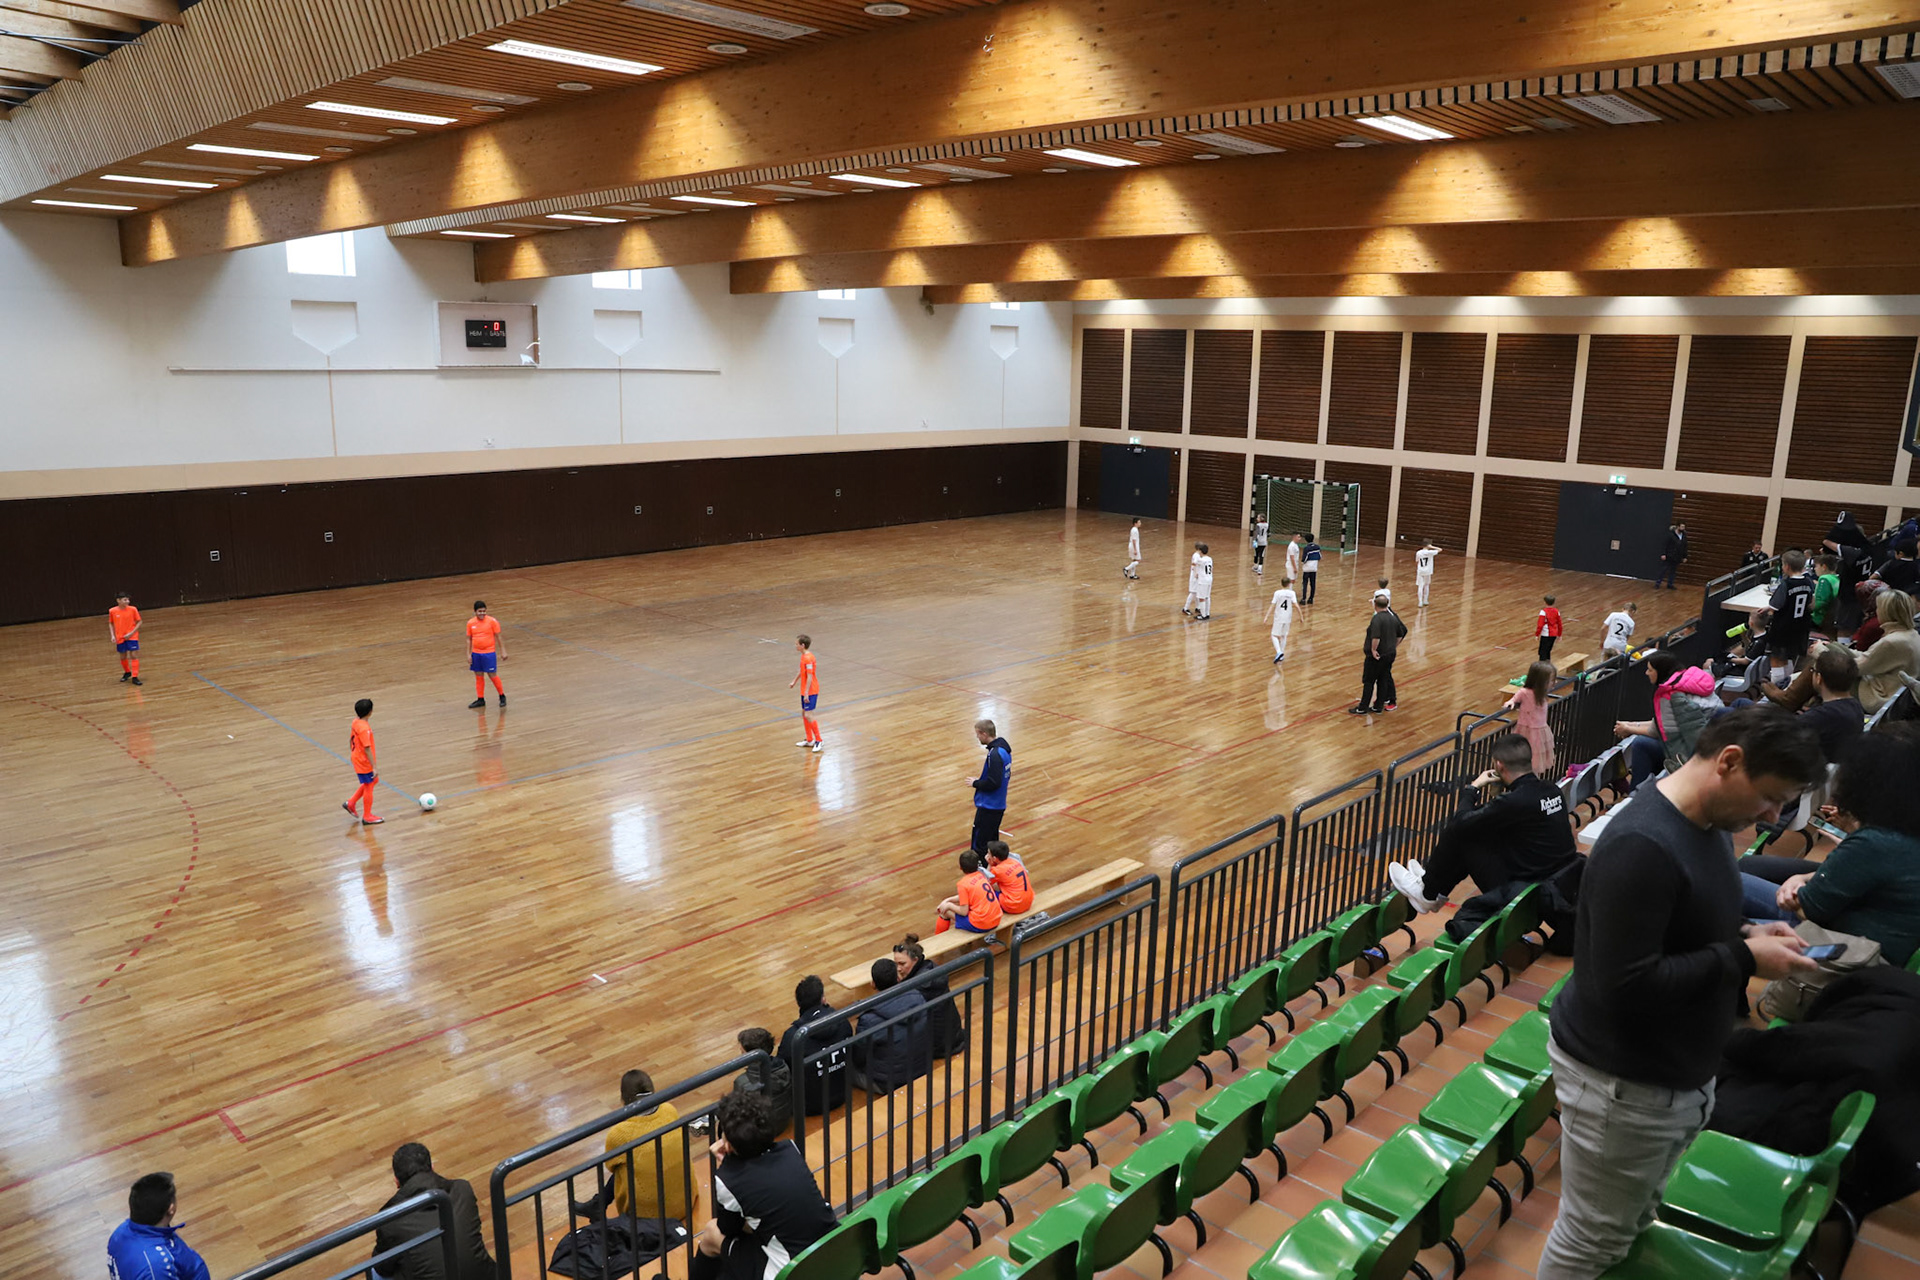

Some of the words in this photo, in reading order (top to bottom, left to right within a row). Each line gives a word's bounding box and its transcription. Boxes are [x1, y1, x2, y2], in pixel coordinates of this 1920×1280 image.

[493, 321, 500, 331] 0
[1419, 557, 1429, 567] 17
[1205, 564, 1213, 575] 13
[1280, 599, 1288, 611] 4
[1793, 594, 1808, 619] 8
[1614, 622, 1624, 636] 2
[1539, 795, 1563, 812] Kickers
[1016, 870, 1028, 892] 7
[982, 882, 996, 902] 8
